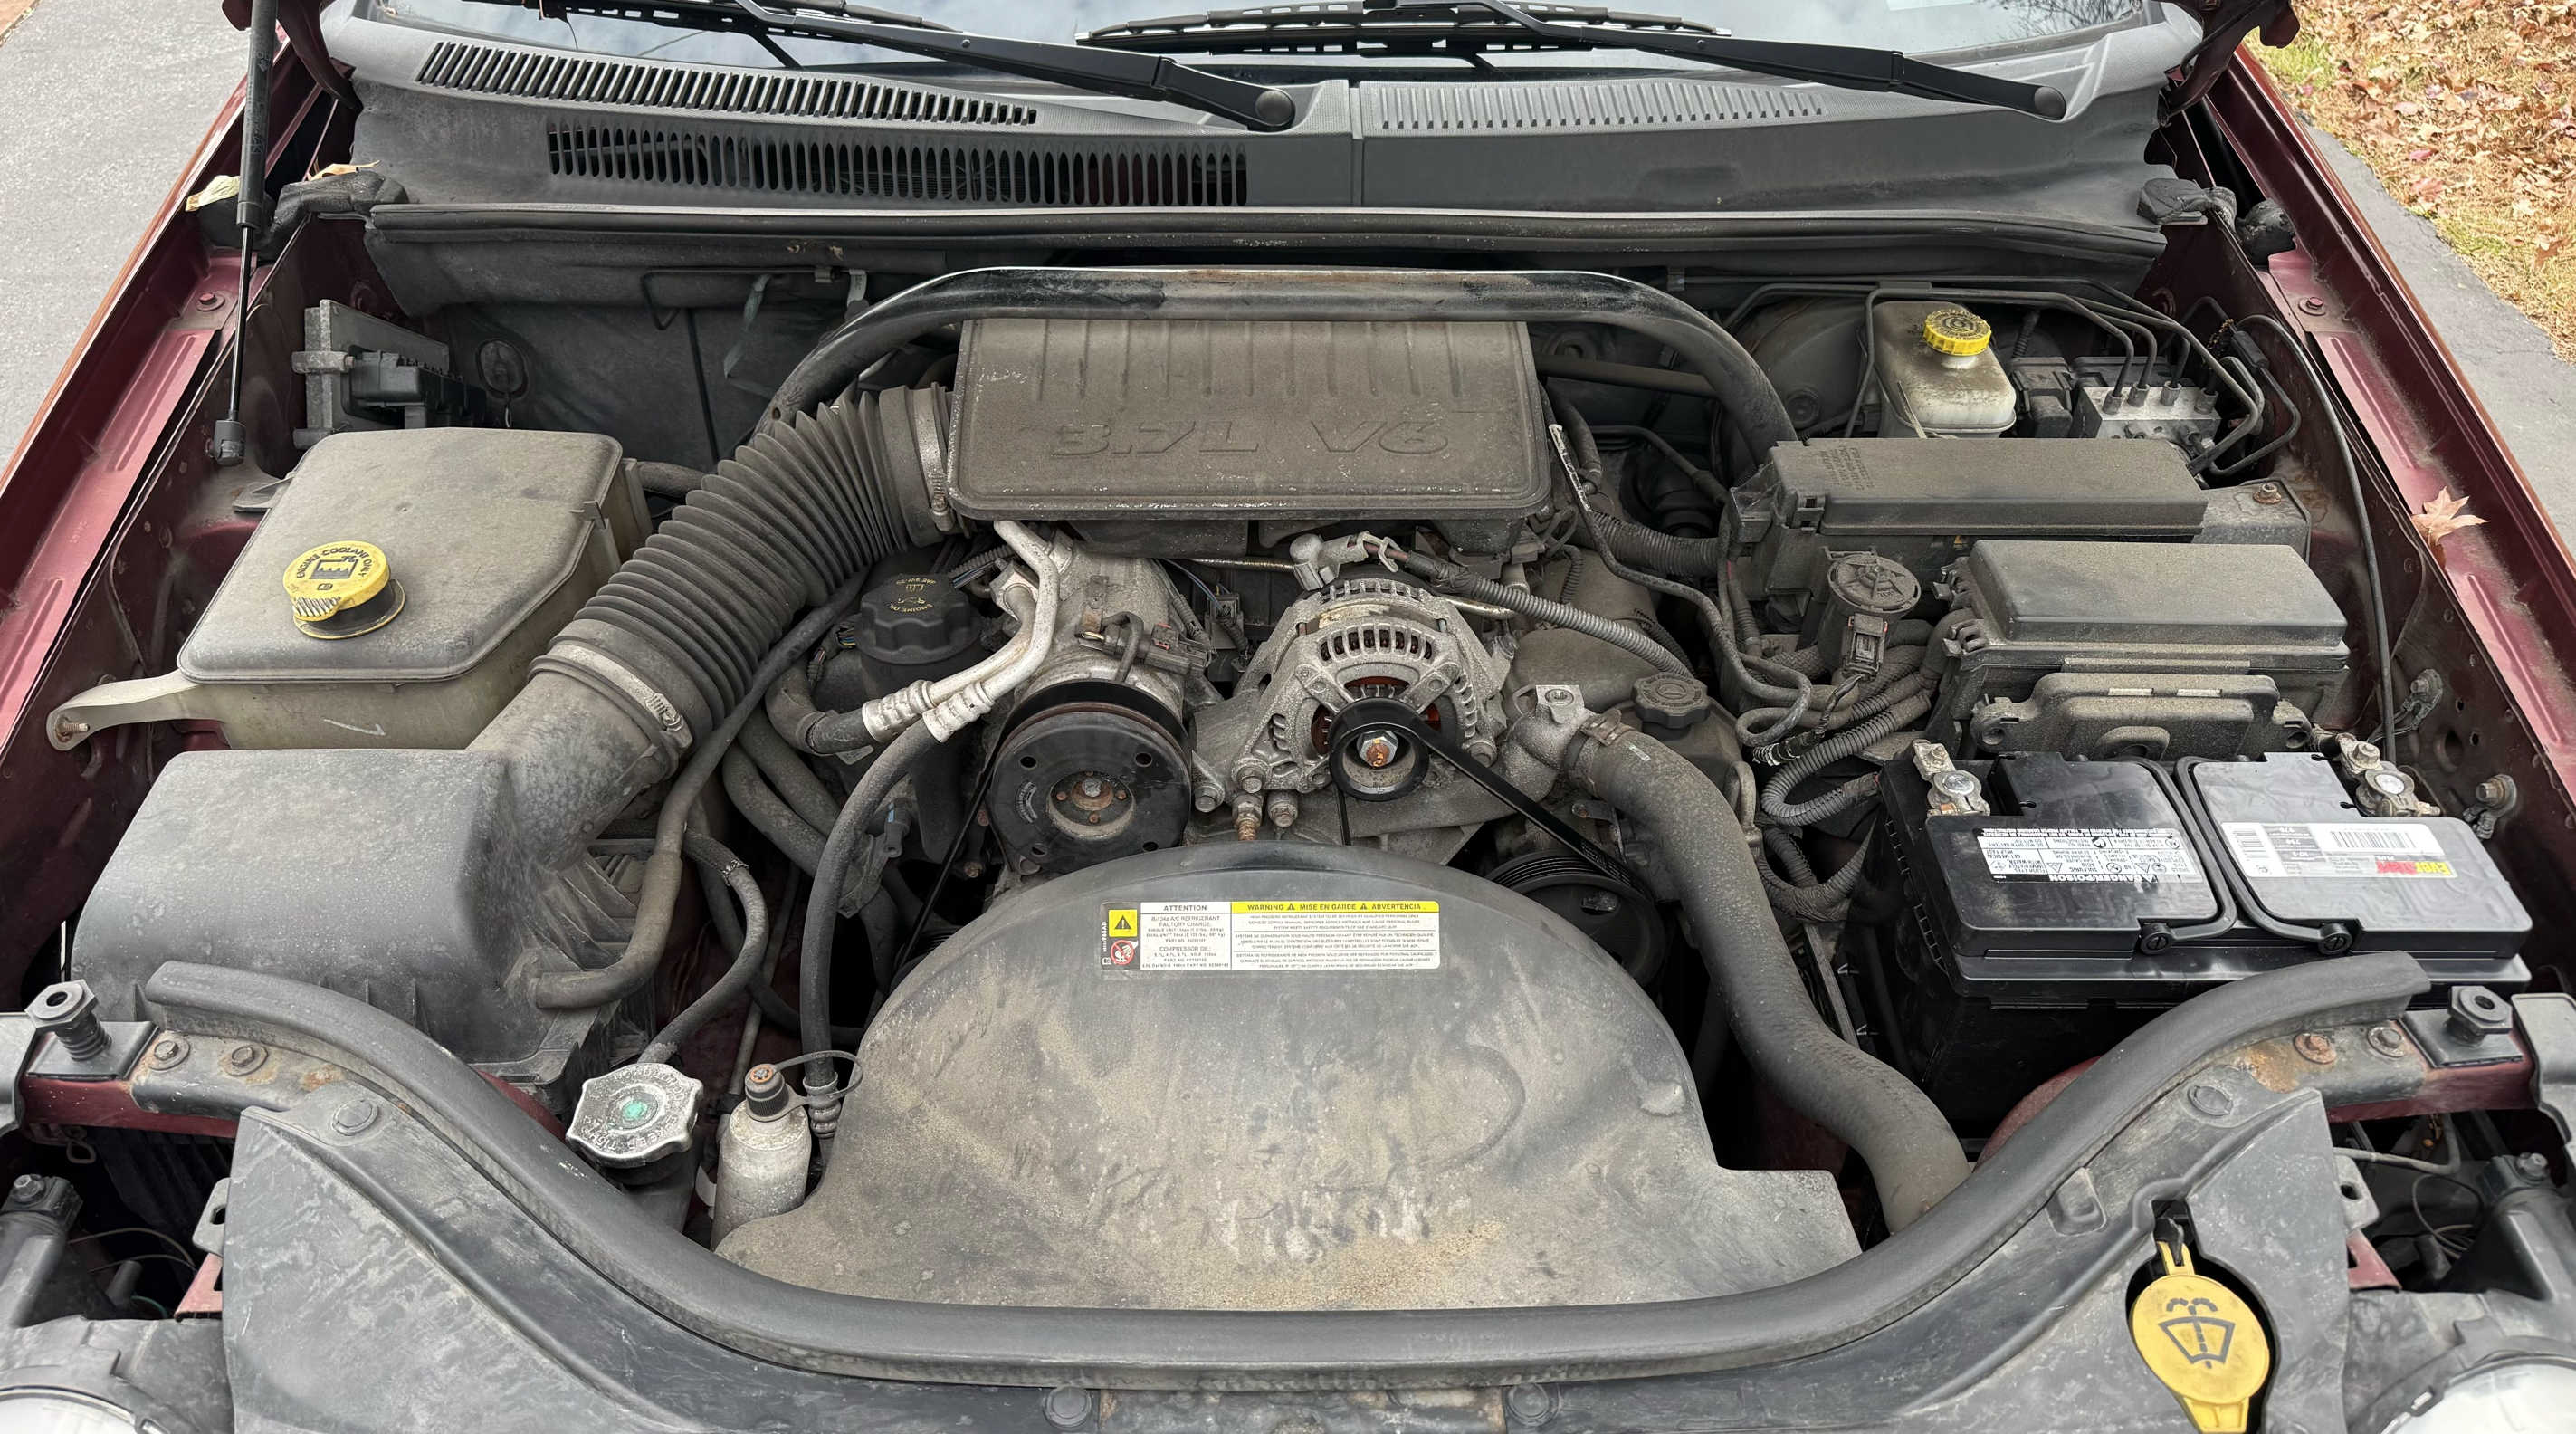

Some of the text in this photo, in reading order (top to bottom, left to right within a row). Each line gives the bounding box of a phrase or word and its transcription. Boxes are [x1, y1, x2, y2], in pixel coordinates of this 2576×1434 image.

[1051, 421, 1448, 455] 3.7L V6
[296, 547, 372, 578] ENGINE COOLANT ONLY
[901, 604, 932, 612] ENGINE
[2376, 861, 2452, 875] EverStart
